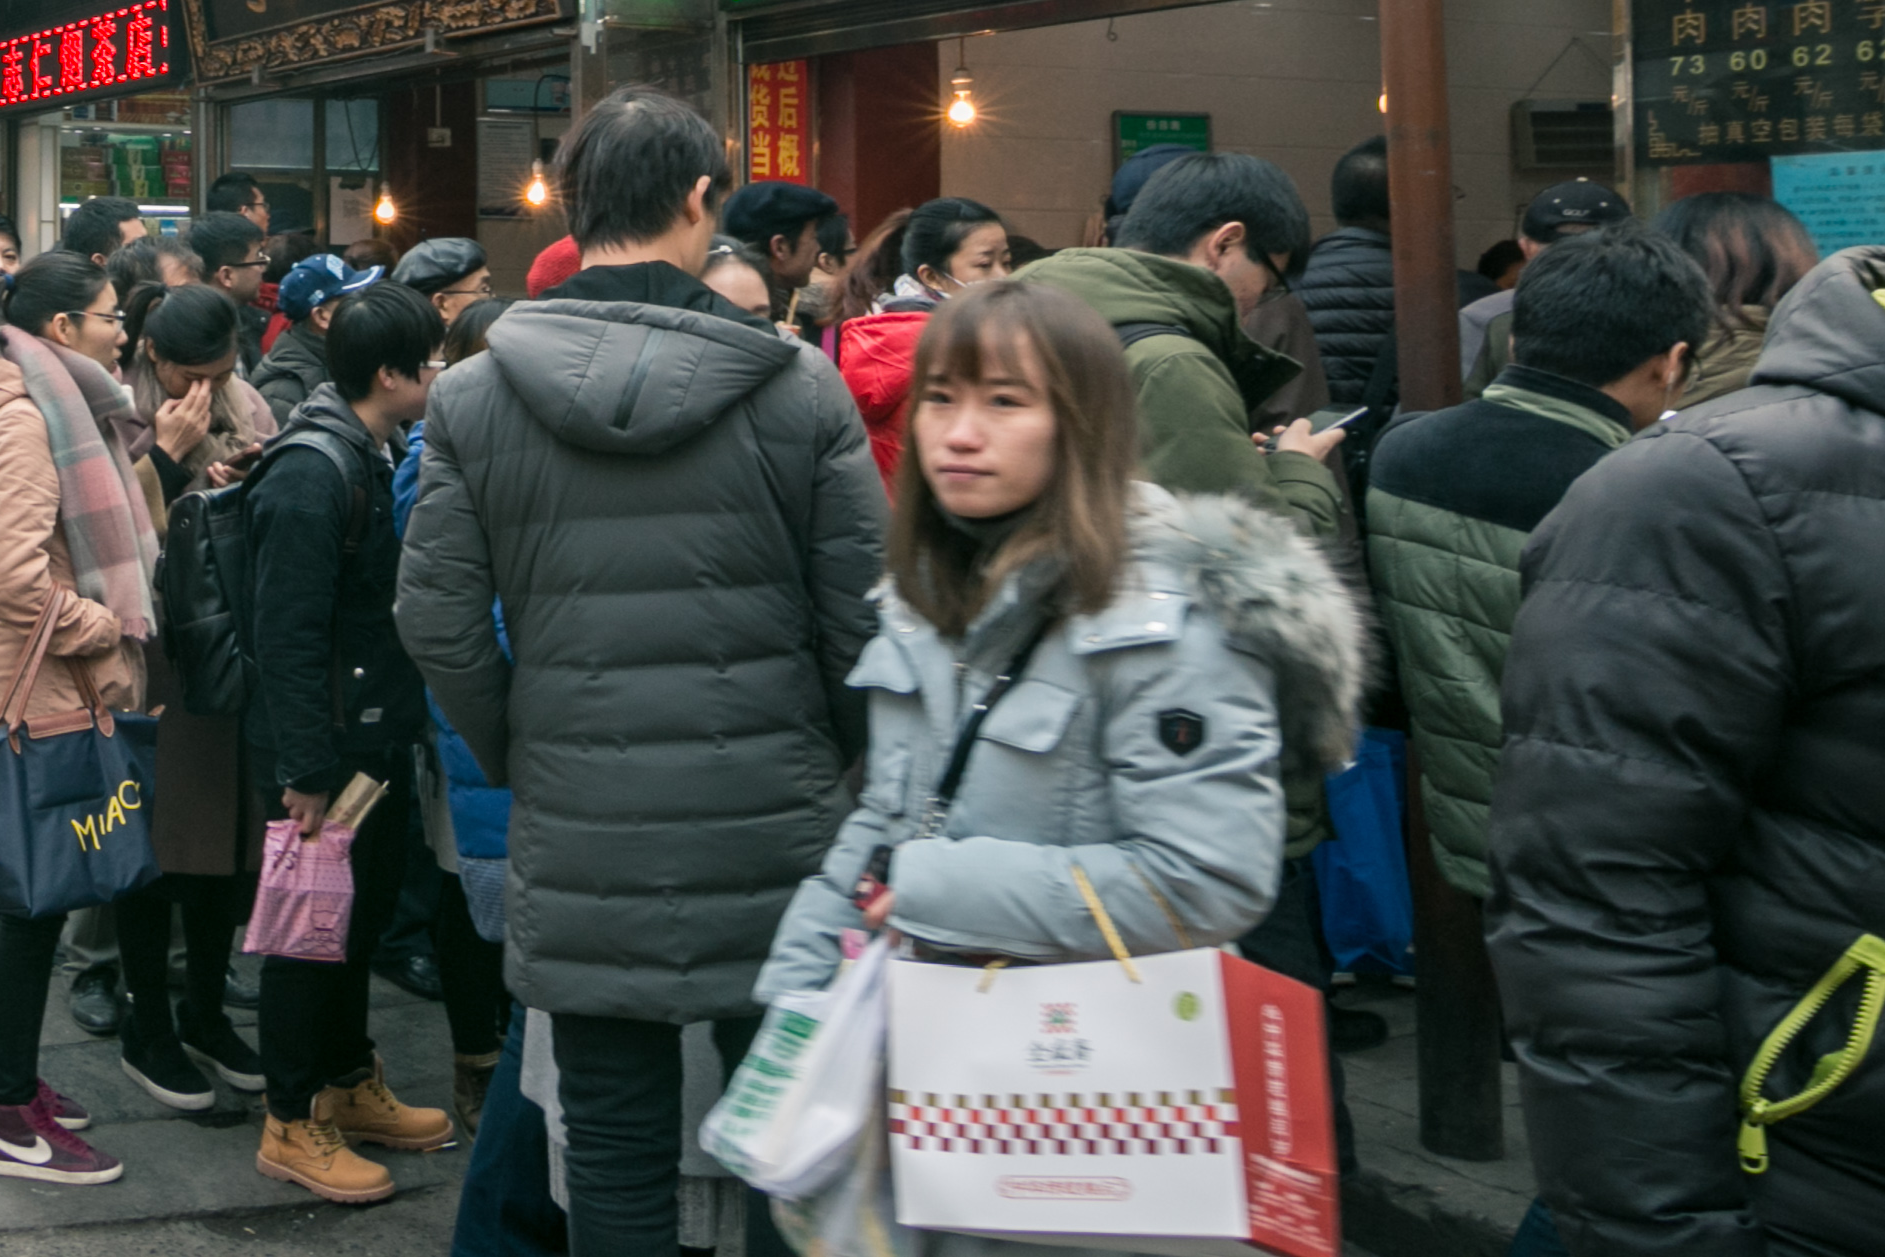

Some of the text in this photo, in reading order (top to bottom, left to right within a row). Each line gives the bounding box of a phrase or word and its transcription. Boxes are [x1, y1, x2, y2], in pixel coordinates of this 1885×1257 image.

[1670, 54, 1705, 76] 73
[1729, 49, 1766, 71] 60
[1792, 44, 1831, 67] 62
